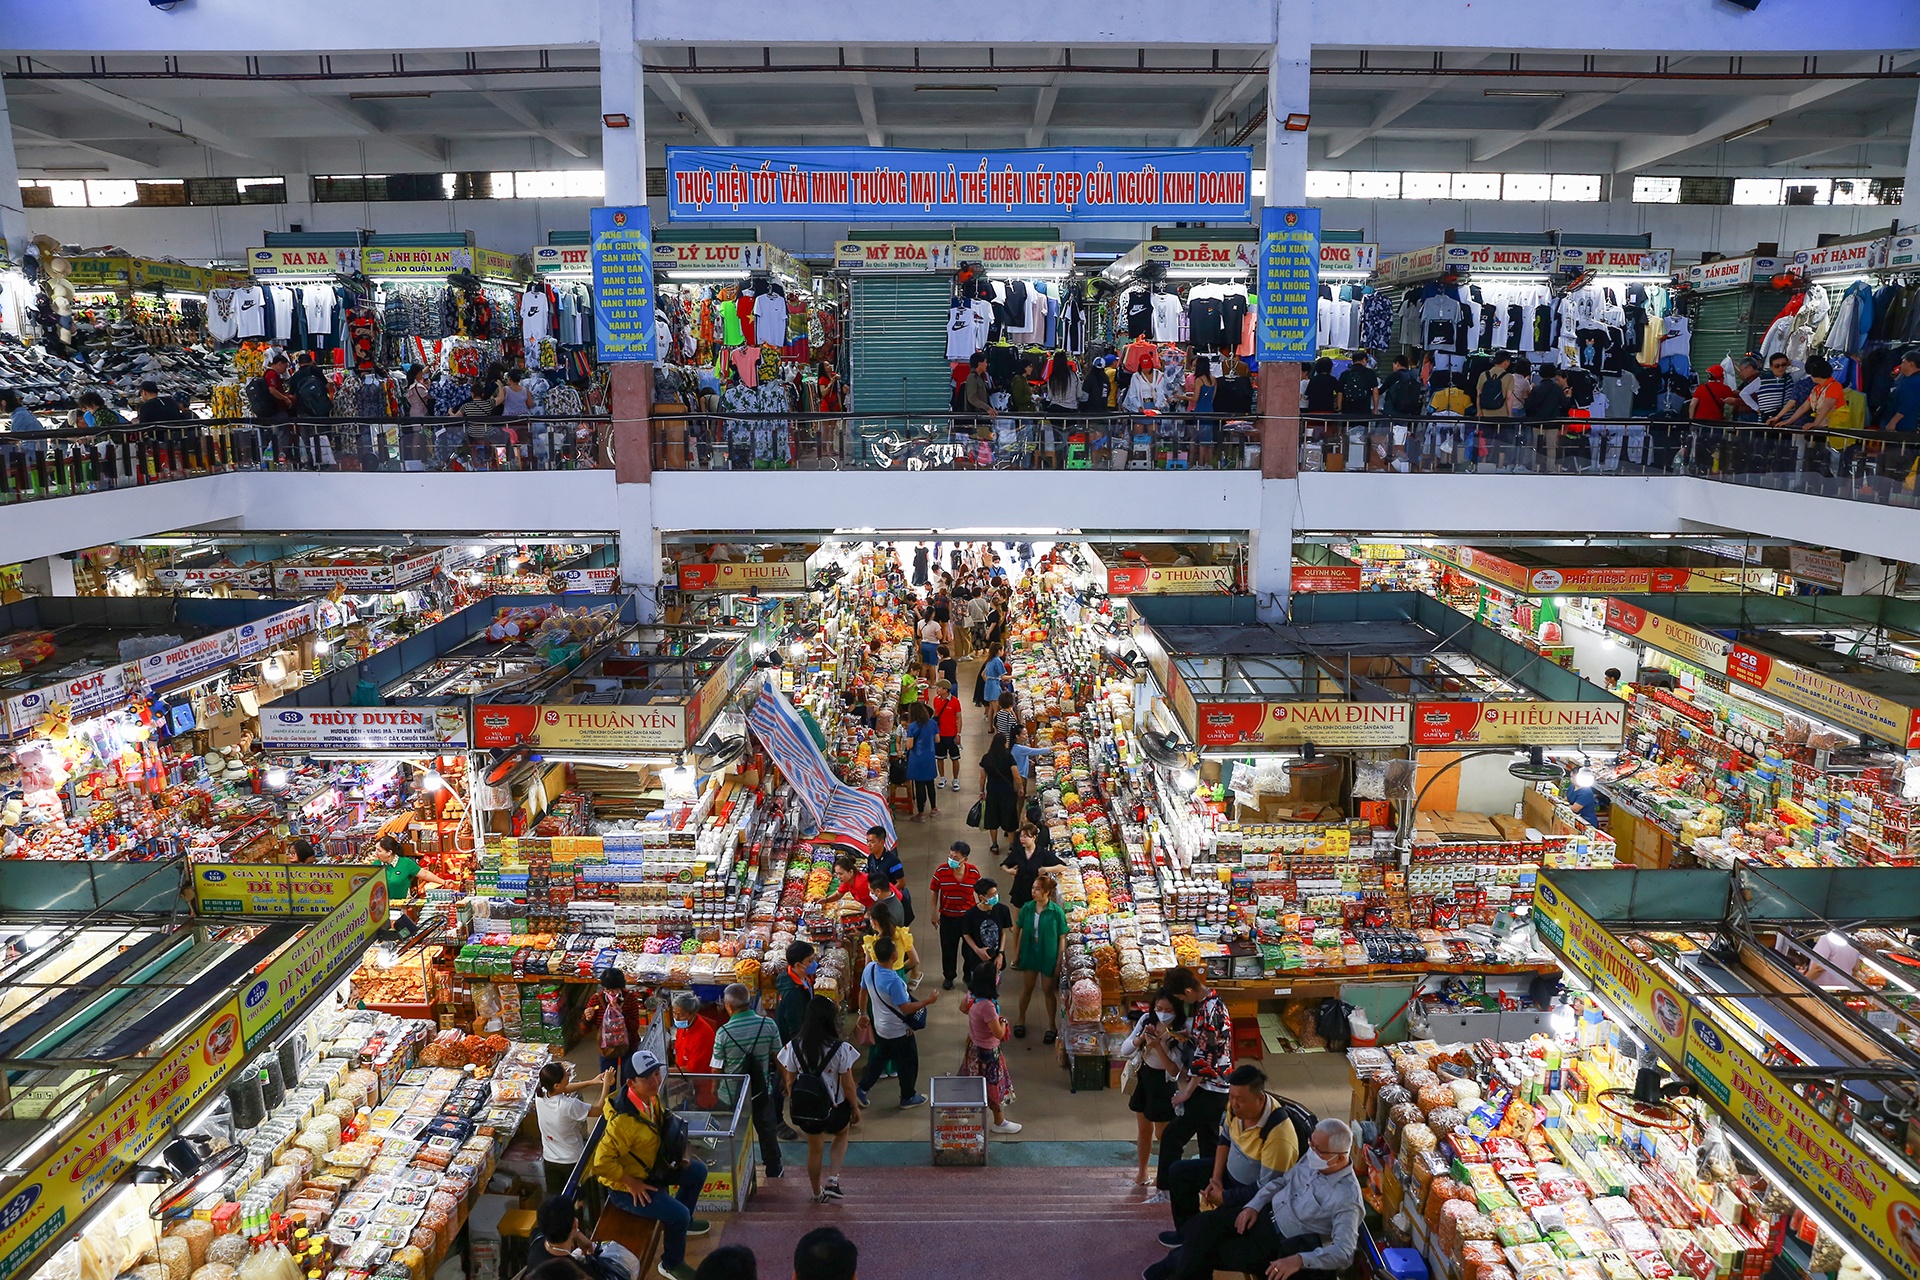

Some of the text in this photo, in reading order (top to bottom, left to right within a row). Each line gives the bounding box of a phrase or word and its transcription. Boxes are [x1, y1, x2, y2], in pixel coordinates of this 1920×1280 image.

[676, 158, 1245, 212] THỰC HIỆN TỐT VĂN MINH THƯƠNG MẠI LÀ THỂ HIỆN NÉT ĐẸP CỦA NGƯỜI KINH DOANH
[283, 253, 304, 265] NA
[307, 253, 328, 264] NA
[417, 250, 449, 265] HỘI AN
[678, 244, 700, 260] LÝ
[866, 244, 927, 259] MỸ HÒA
[984, 246, 1046, 260] HƯƠNG SEN
[1173, 244, 1230, 261] DIỄM
[1471, 247, 1532, 263] TỐ MINH
[1586, 250, 1606, 264] MỸ
[1811, 247, 1866, 264] MỸ HẠNH
[602, 265, 624, 273] BUÔN
[1270, 257, 1310, 265] BUÔN BÁN
[148, 264, 170, 277] MINH
[1269, 269, 1290, 278] HÀNG
[1282, 281, 1310, 290] KHÔNG
[1268, 306, 1289, 314] HÀNG
[609, 322, 631, 330] HÀNH
[1277, 318, 1309, 326] HÀNH VI
[741, 564, 790, 578] THU HÀ
[1166, 568, 1210, 581] THUẬN
[1566, 574, 1594, 584] PHÁT
[1665, 624, 1720, 654] ĐỨC THƯƠNG
[166, 648, 189, 665] PHÚC
[1733, 651, 1741, 659] LÔ
[1741, 652, 1758, 666] 26
[1793, 670, 1880, 711] THU TRANG
[284, 713, 298, 721] 53
[310, 710, 423, 725] THÙY DUYÊN
[564, 709, 676, 730] THUẬN YẾN
[1291, 706, 1405, 725] NAM ĐỊNH
[1503, 705, 1620, 725] HIẾU NHÂN
[272, 870, 306, 879] THỰC
[310, 869, 344, 879] PHẨM
[247, 878, 333, 894] DÌ NUÔI
[291, 902, 355, 961] GIA VỊ THỰC PHẨM
[1561, 901, 1576, 919] GIA
[1579, 917, 1588, 930] VỊ
[1590, 927, 1618, 954] THỰC
[1620, 953, 1652, 986] PHẨM
[1570, 939, 1590, 960] Chuyên
[1582, 934, 1604, 962] ANH
[278, 908, 368, 997] DÌ NUÔI (Thương)
[1568, 948, 1580, 962] TÔM
[283, 997, 296, 1013] TÔM
[1701, 1022, 1715, 1039] LÔ
[1700, 1031, 1716, 1050] 152
[1690, 1035, 1722, 1067] CHỢ HÀN
[1730, 1069, 1784, 1126] DIỆU
[47, 1039, 200, 1178] GIA VỊ THỰC PHẨM
[1728, 1049, 1754, 1078] GIA
[1758, 1074, 1774, 1096] VỊ
[1778, 1092, 1826, 1138] THỰC
[1829, 1137, 1888, 1194] PHẨM
[1743, 1102, 1776, 1135] Chuyên
[1779, 1137, 1799, 1158] bán
[81, 1063, 226, 1204] TÔM CÁ MỰC KHÔ CÁC LOẠI
[70, 1110, 140, 1182] CHỊ
[81, 1154, 118, 1192] Chuyên
[123, 1132, 142, 1153] bán
[1741, 1112, 1760, 1134] TÔM
[1767, 1137, 1778, 1151] CÁ
[1788, 1156, 1809, 1180] MỰC
[1835, 1202, 1856, 1224] KHÔ
[1861, 1223, 1884, 1248] CÁC
[2, 1198, 30, 1228] 137
[4, 1195, 26, 1216] LÔ
[20, 1202, 45, 1228] HÀN
